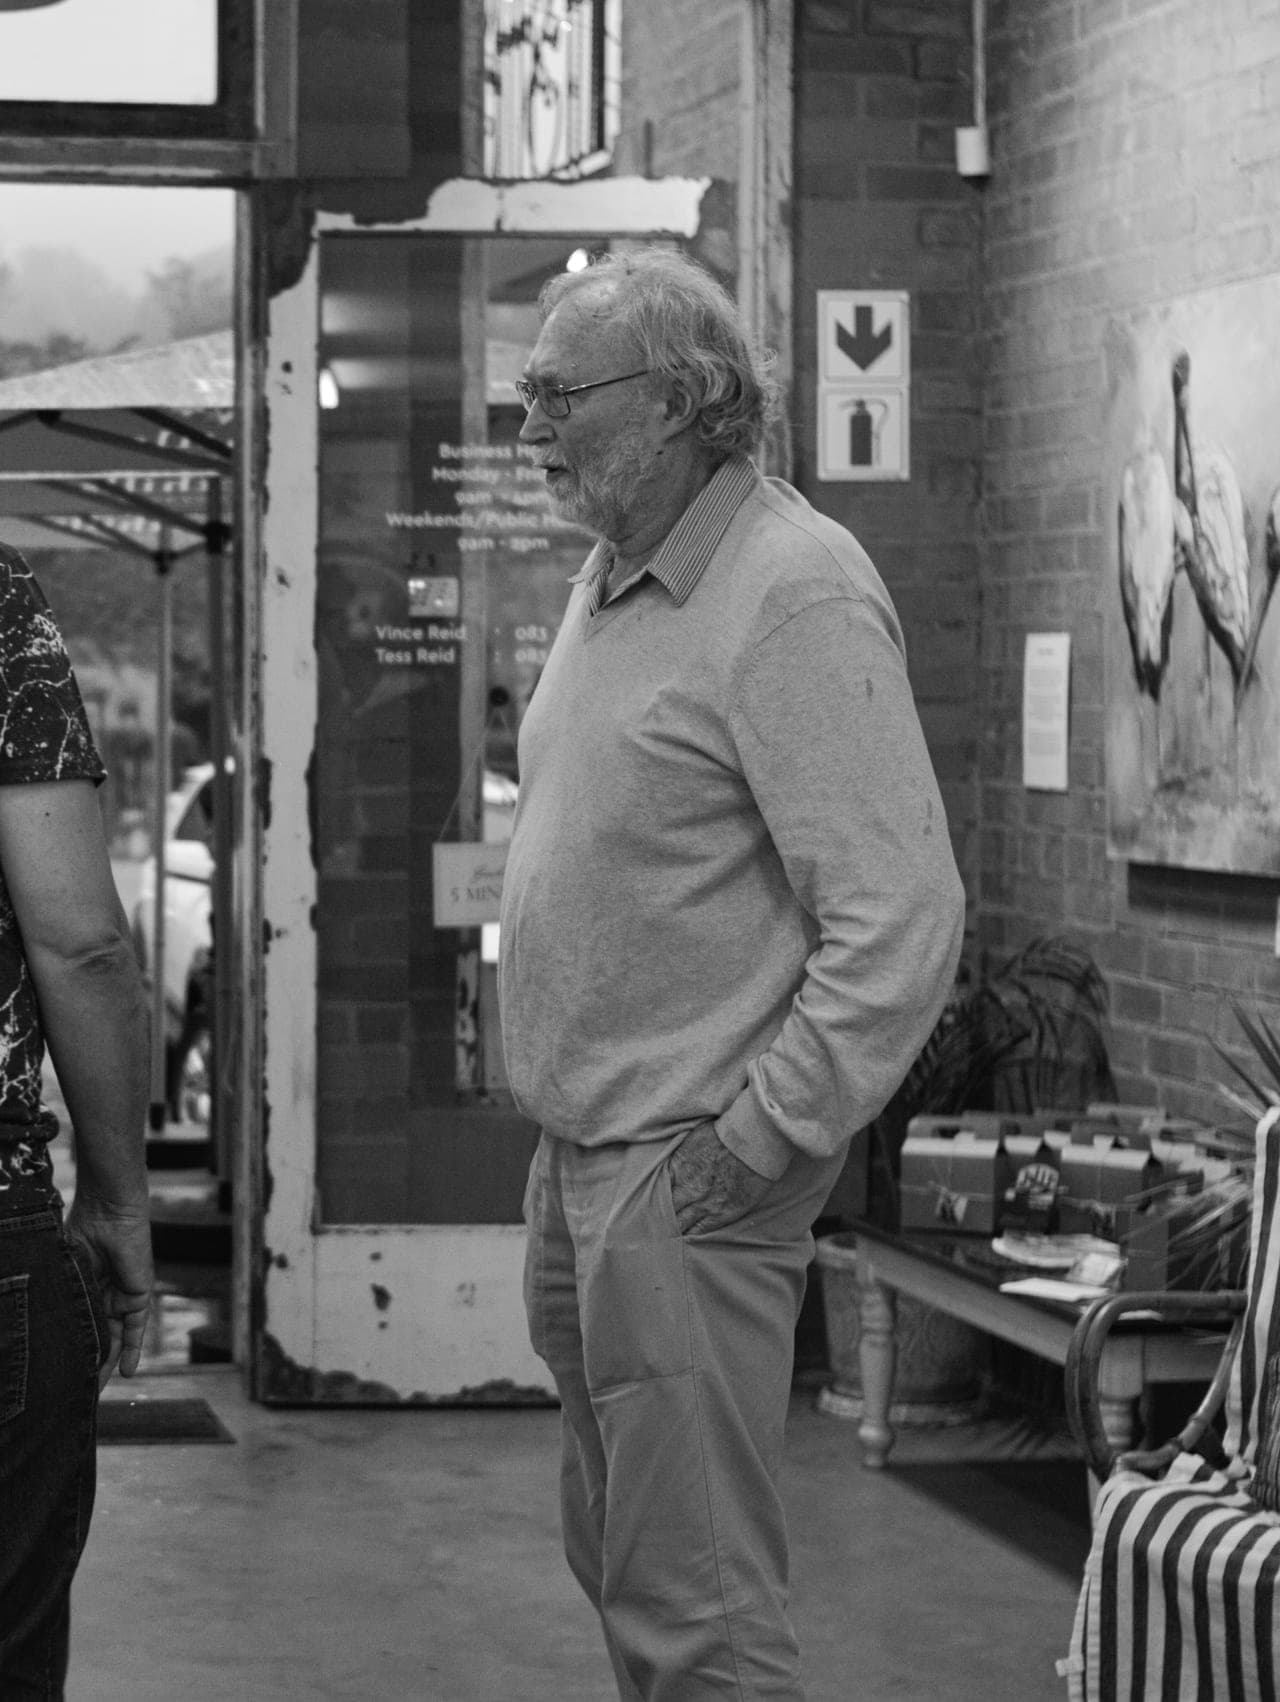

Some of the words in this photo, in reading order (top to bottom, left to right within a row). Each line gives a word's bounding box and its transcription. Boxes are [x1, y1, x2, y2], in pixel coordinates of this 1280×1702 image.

[438, 443, 512, 459] Business
[431, 467, 498, 486] Monday
[385, 510, 537, 529] Weekends/Public
[375, 625, 424, 641] Vince
[428, 624, 468, 641] Reid
[375, 648, 412, 664] Tess
[417, 647, 455, 664] Reid
